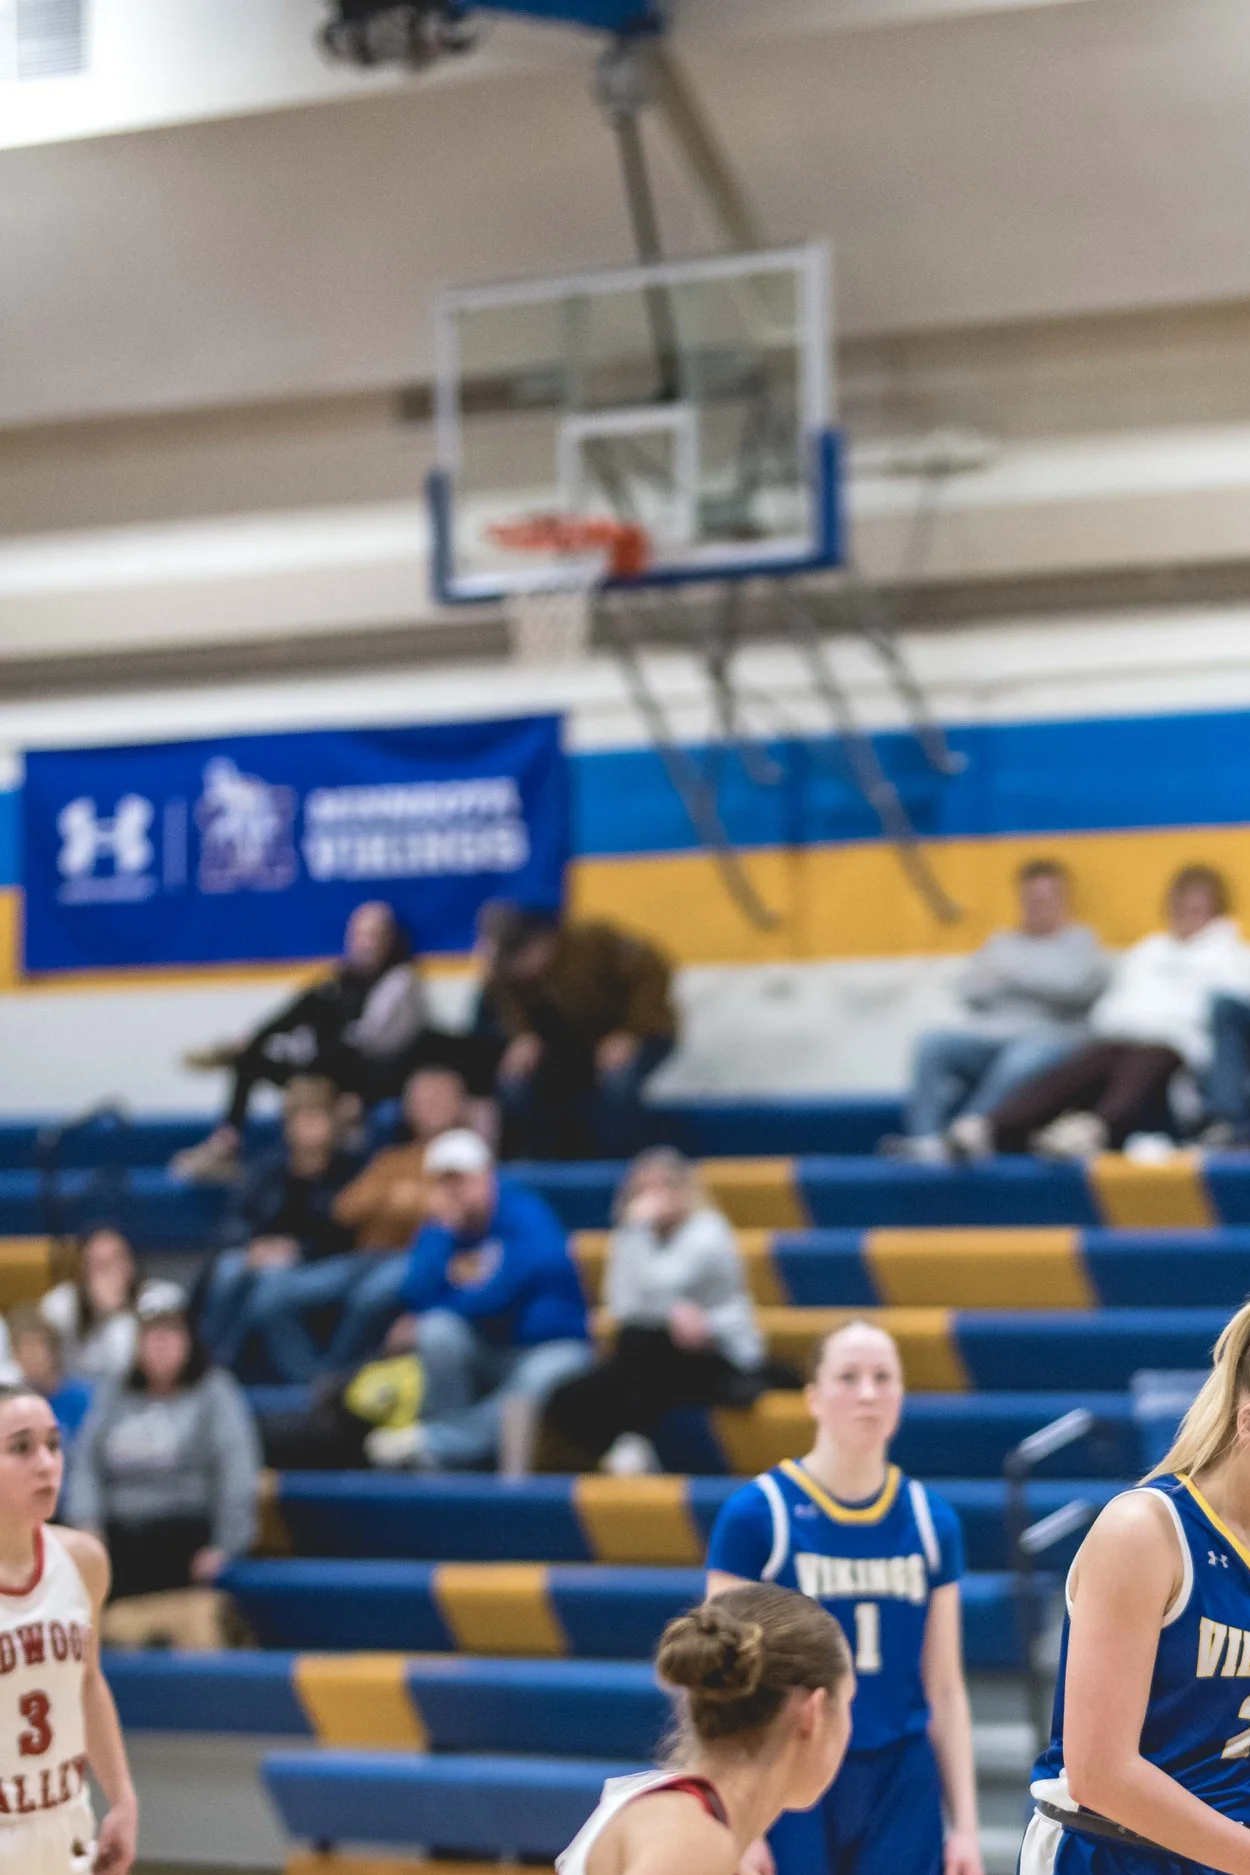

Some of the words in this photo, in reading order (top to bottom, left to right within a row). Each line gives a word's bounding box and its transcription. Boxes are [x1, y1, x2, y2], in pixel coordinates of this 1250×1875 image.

[794, 1552, 926, 1605] VIKINGS
[854, 1602, 882, 1674] 1
[18, 1688, 53, 1756] 3
